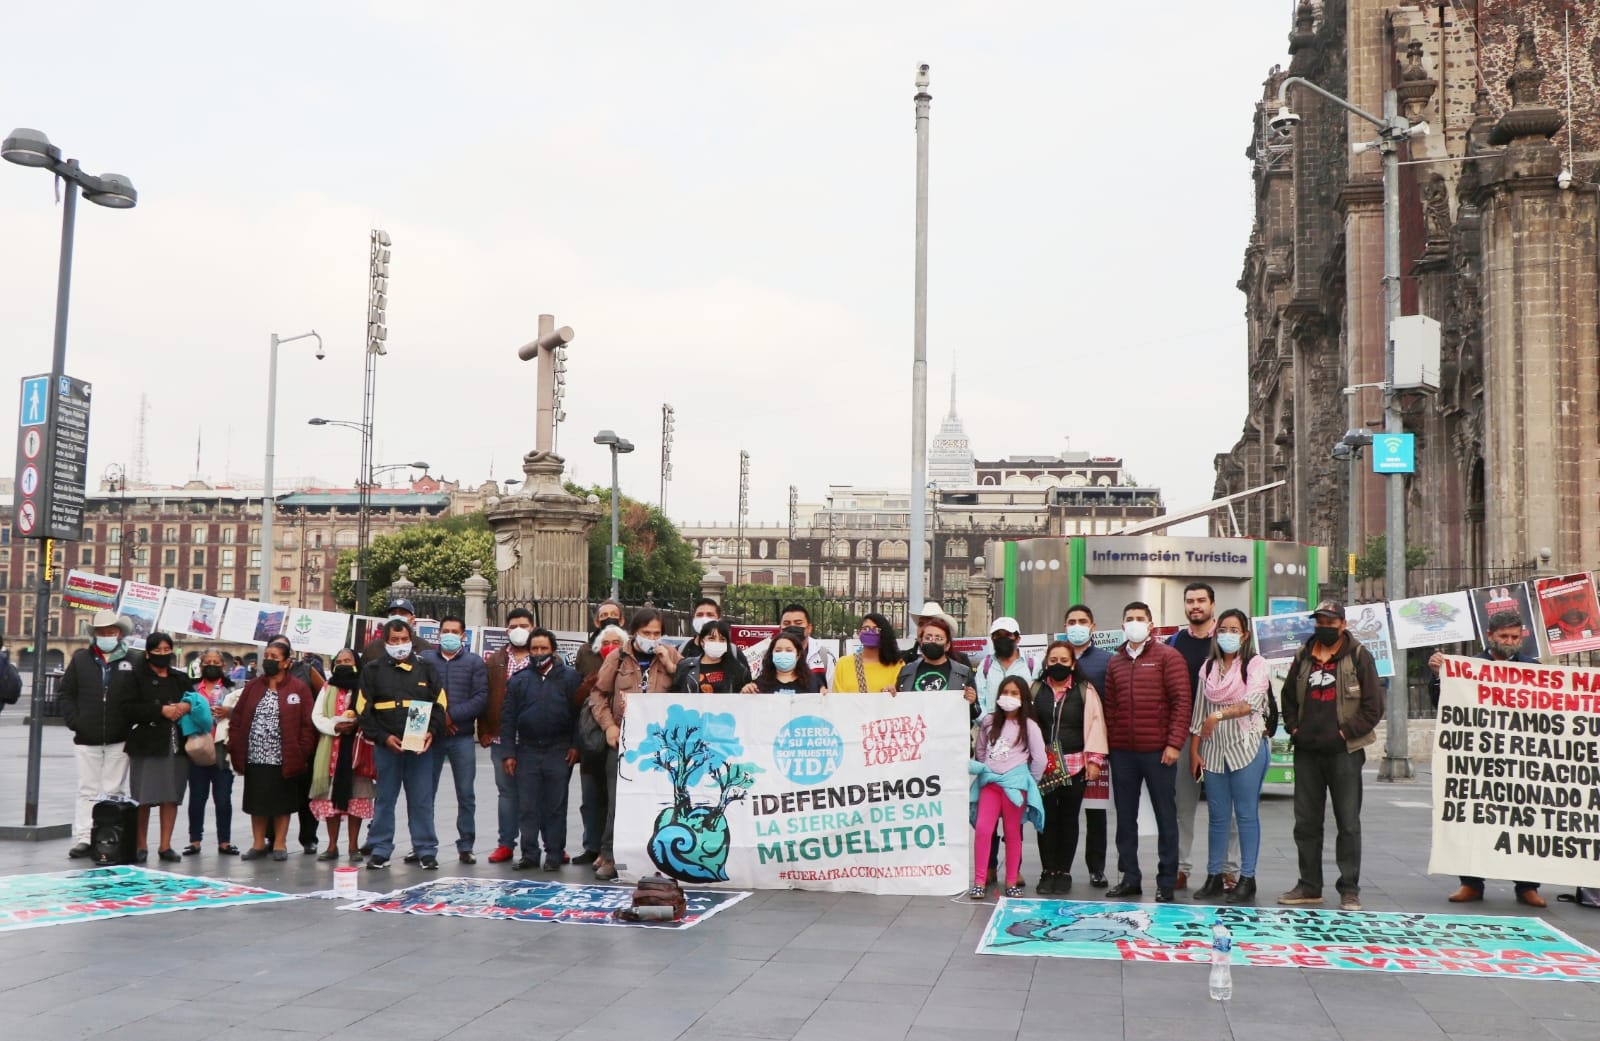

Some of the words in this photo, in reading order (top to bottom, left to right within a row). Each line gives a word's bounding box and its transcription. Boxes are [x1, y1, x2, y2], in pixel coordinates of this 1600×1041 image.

[1092, 550, 1180, 562] Información
[1185, 551, 1248, 563] Turística
[1477, 683, 1600, 714] PRESIDENTE
[789, 738, 803, 748] SU
[807, 738, 839, 748] AGUA
[794, 727, 839, 738] SIERRA
[863, 728, 925, 751] CHATO
[776, 750, 795, 758] SON
[797, 749, 839, 758] NUESTRA
[863, 744, 922, 767] LOPEZ
[1439, 730, 1474, 751] QUE
[1478, 731, 1505, 754] SE
[1510, 736, 1600, 763] REALICE
[777, 757, 839, 777] VIDA
[752, 775, 941, 816] ¡DEFENDEMOS
[1444, 778, 1582, 808] RELACIONADO
[755, 820, 781, 837] LA
[787, 811, 864, 834] SIERRA
[870, 805, 896, 823] DE
[903, 800, 943, 819] SAN
[1442, 801, 1466, 823] DE
[1473, 803, 1537, 827] ESTAS
[757, 823, 946, 865] MIGUELITO!
[1494, 831, 1512, 855] A
[1246, 954, 1331, 966] SE
